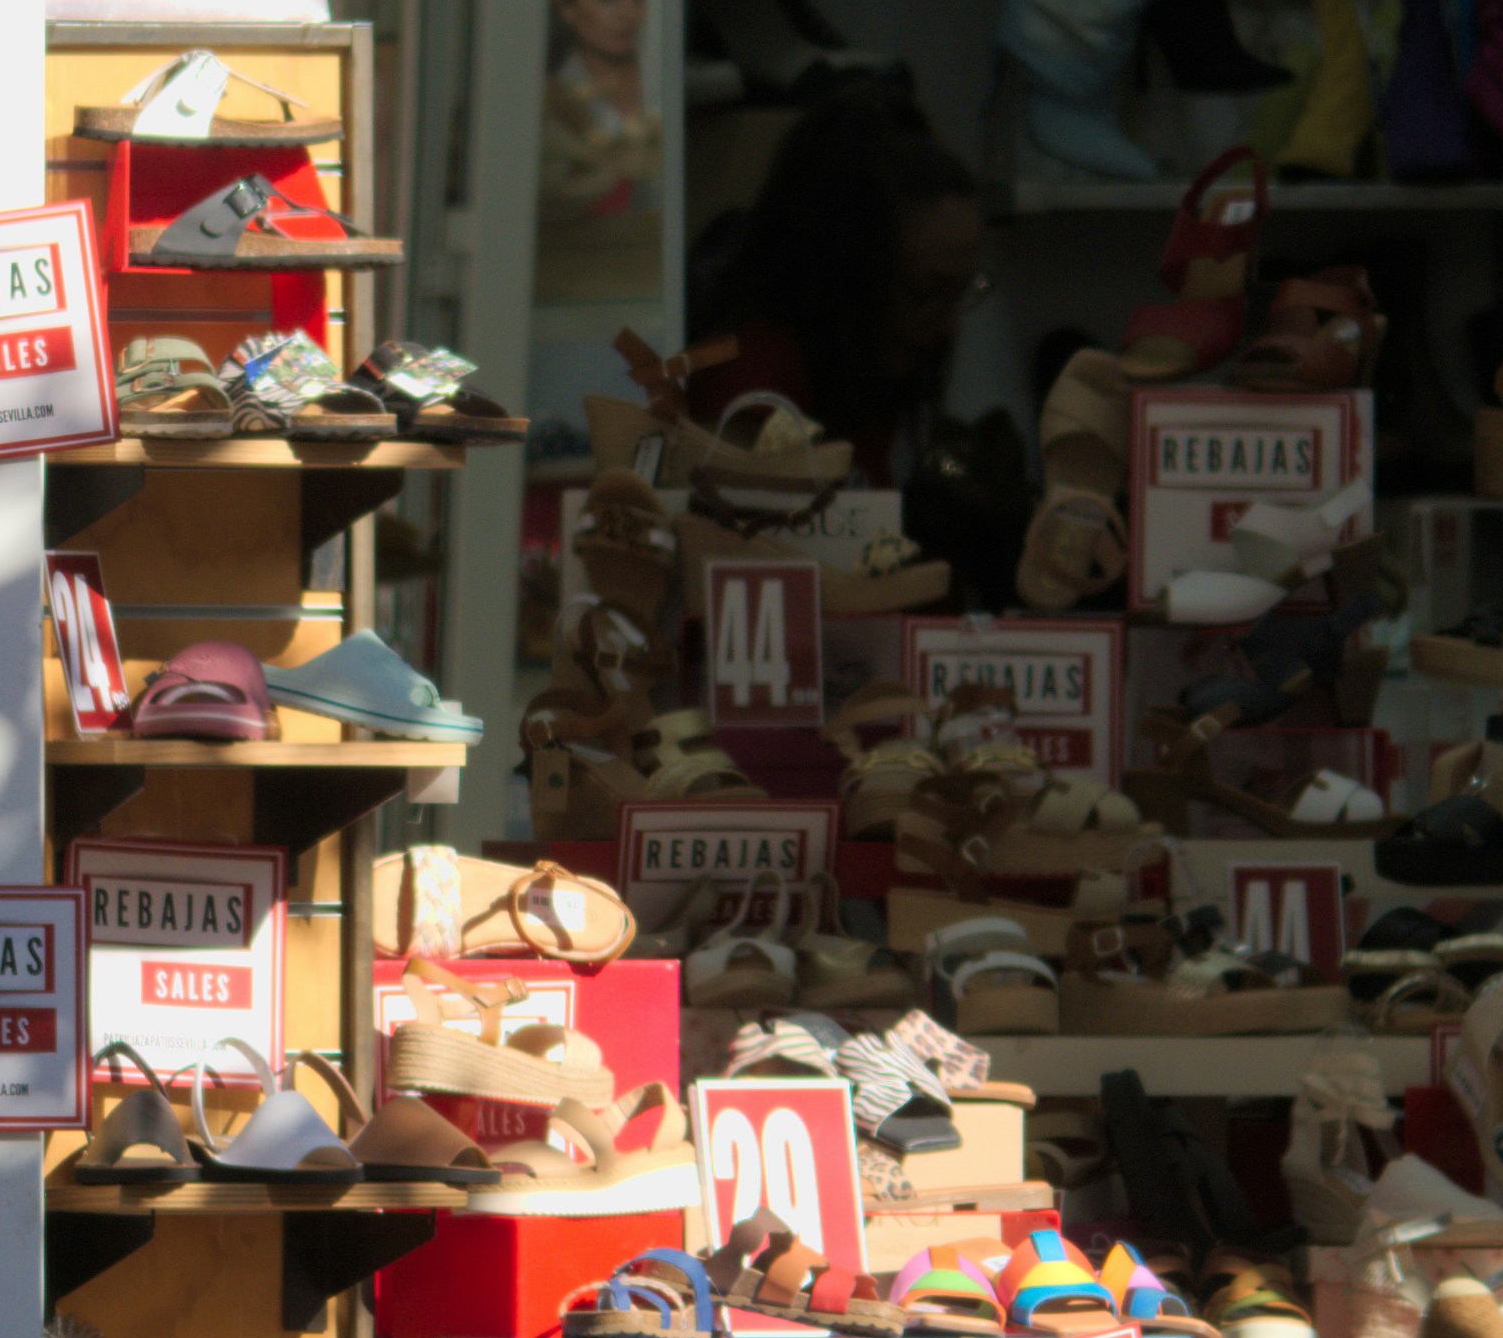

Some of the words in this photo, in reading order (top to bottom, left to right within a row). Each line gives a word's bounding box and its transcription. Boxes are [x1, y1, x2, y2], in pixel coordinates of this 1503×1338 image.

[1163, 437, 1311, 475] REBAJAS
[932, 662, 1081, 699] REBAJAS
[646, 839, 796, 869] REBAJAS
[94, 888, 242, 934] REBAJAS
[156, 969, 230, 1002] SALES
